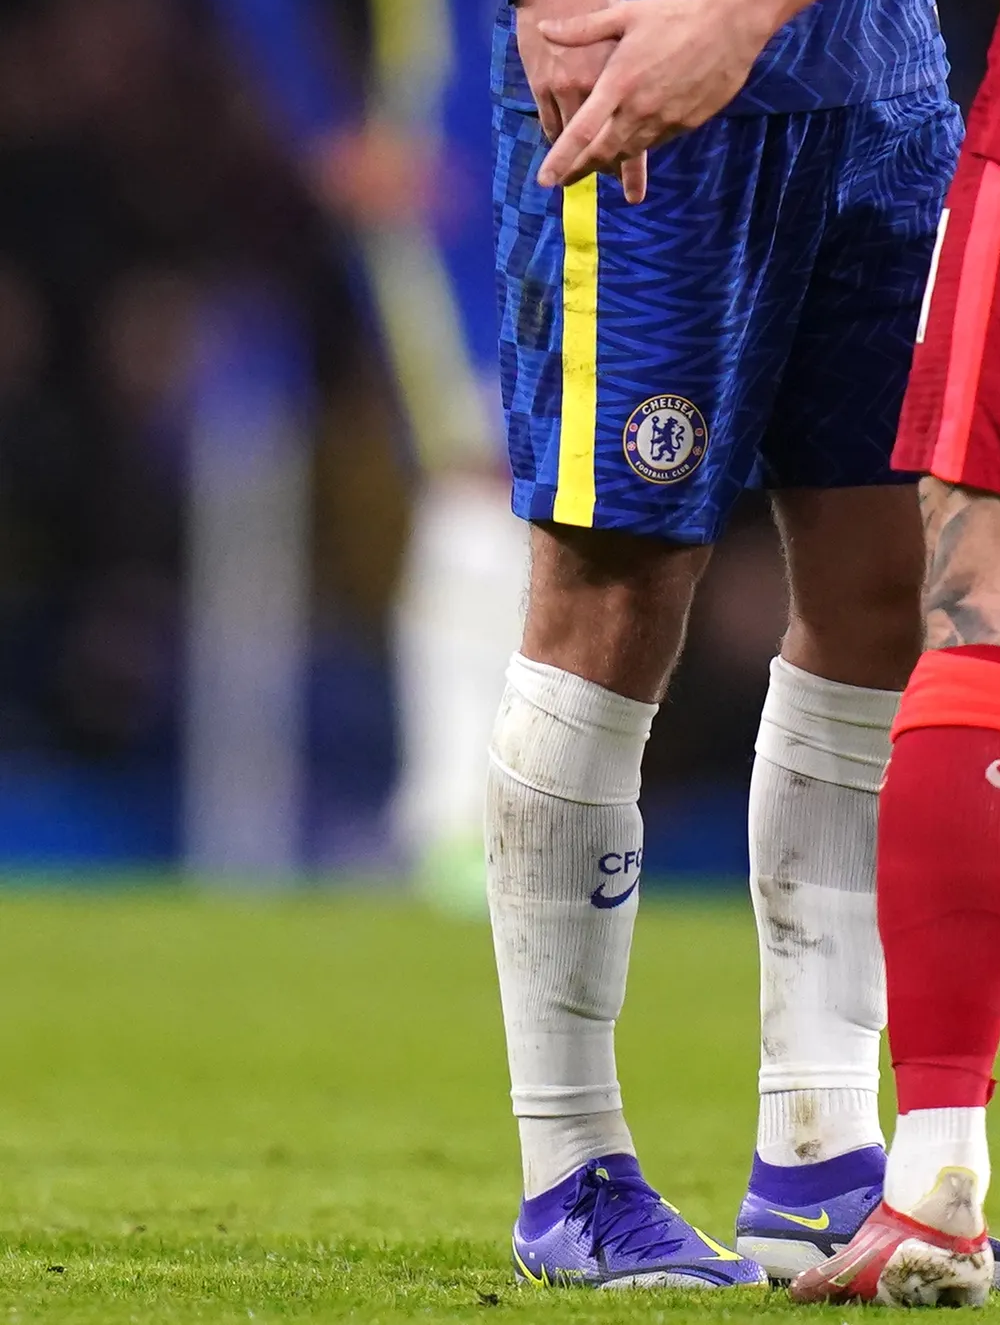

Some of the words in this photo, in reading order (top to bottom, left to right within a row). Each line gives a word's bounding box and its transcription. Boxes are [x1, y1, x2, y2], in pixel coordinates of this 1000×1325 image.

[642, 398, 695, 419] CHELSEA
[635, 460, 669, 479] FOOTBALL
[672, 464, 690, 477] CLUB
